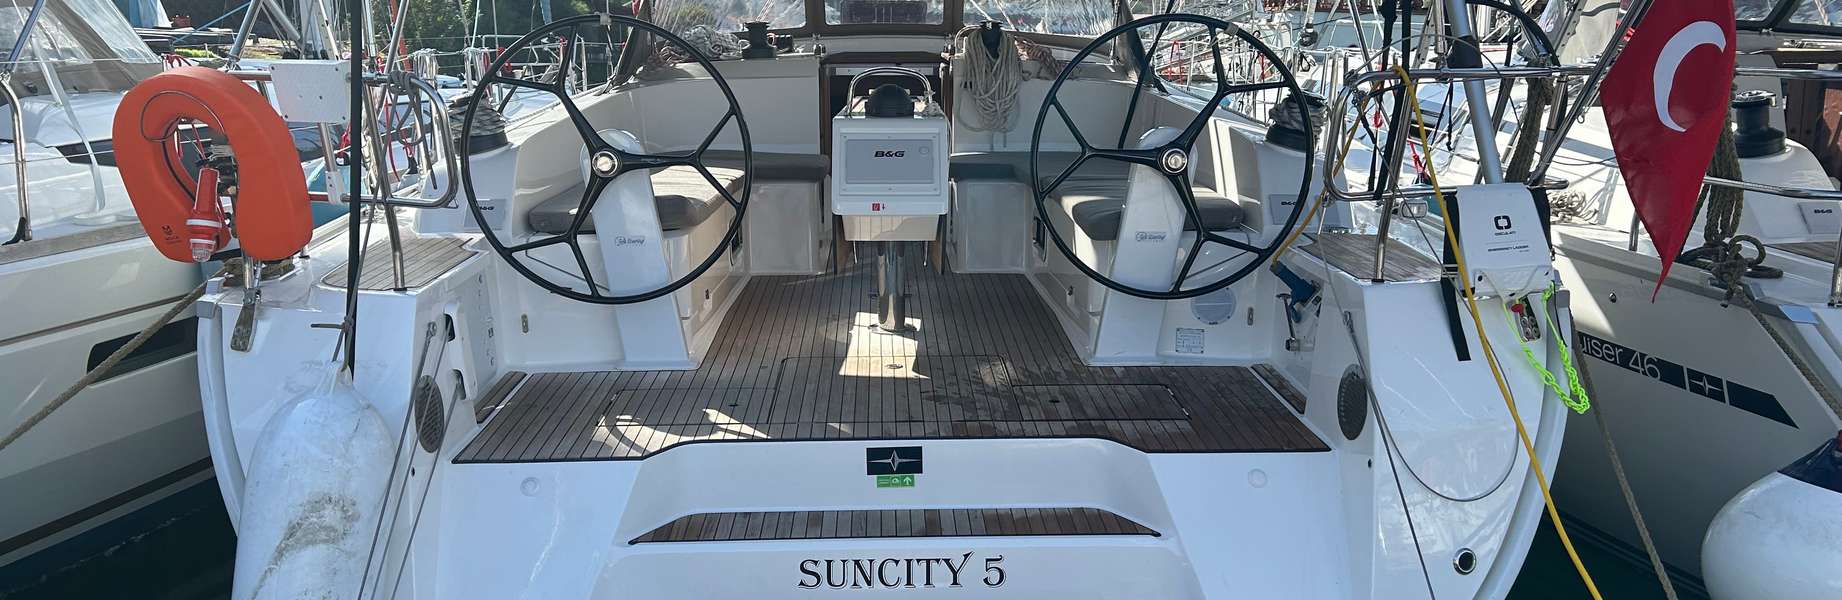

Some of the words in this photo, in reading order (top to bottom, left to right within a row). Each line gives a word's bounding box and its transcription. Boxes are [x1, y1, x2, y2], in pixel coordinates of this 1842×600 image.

[874, 150, 905, 158] B&G
[1582, 336, 1623, 364] uiser
[1629, 352, 1661, 380] 46
[797, 551, 975, 589] SUNCITY
[983, 555, 1006, 587] 5
